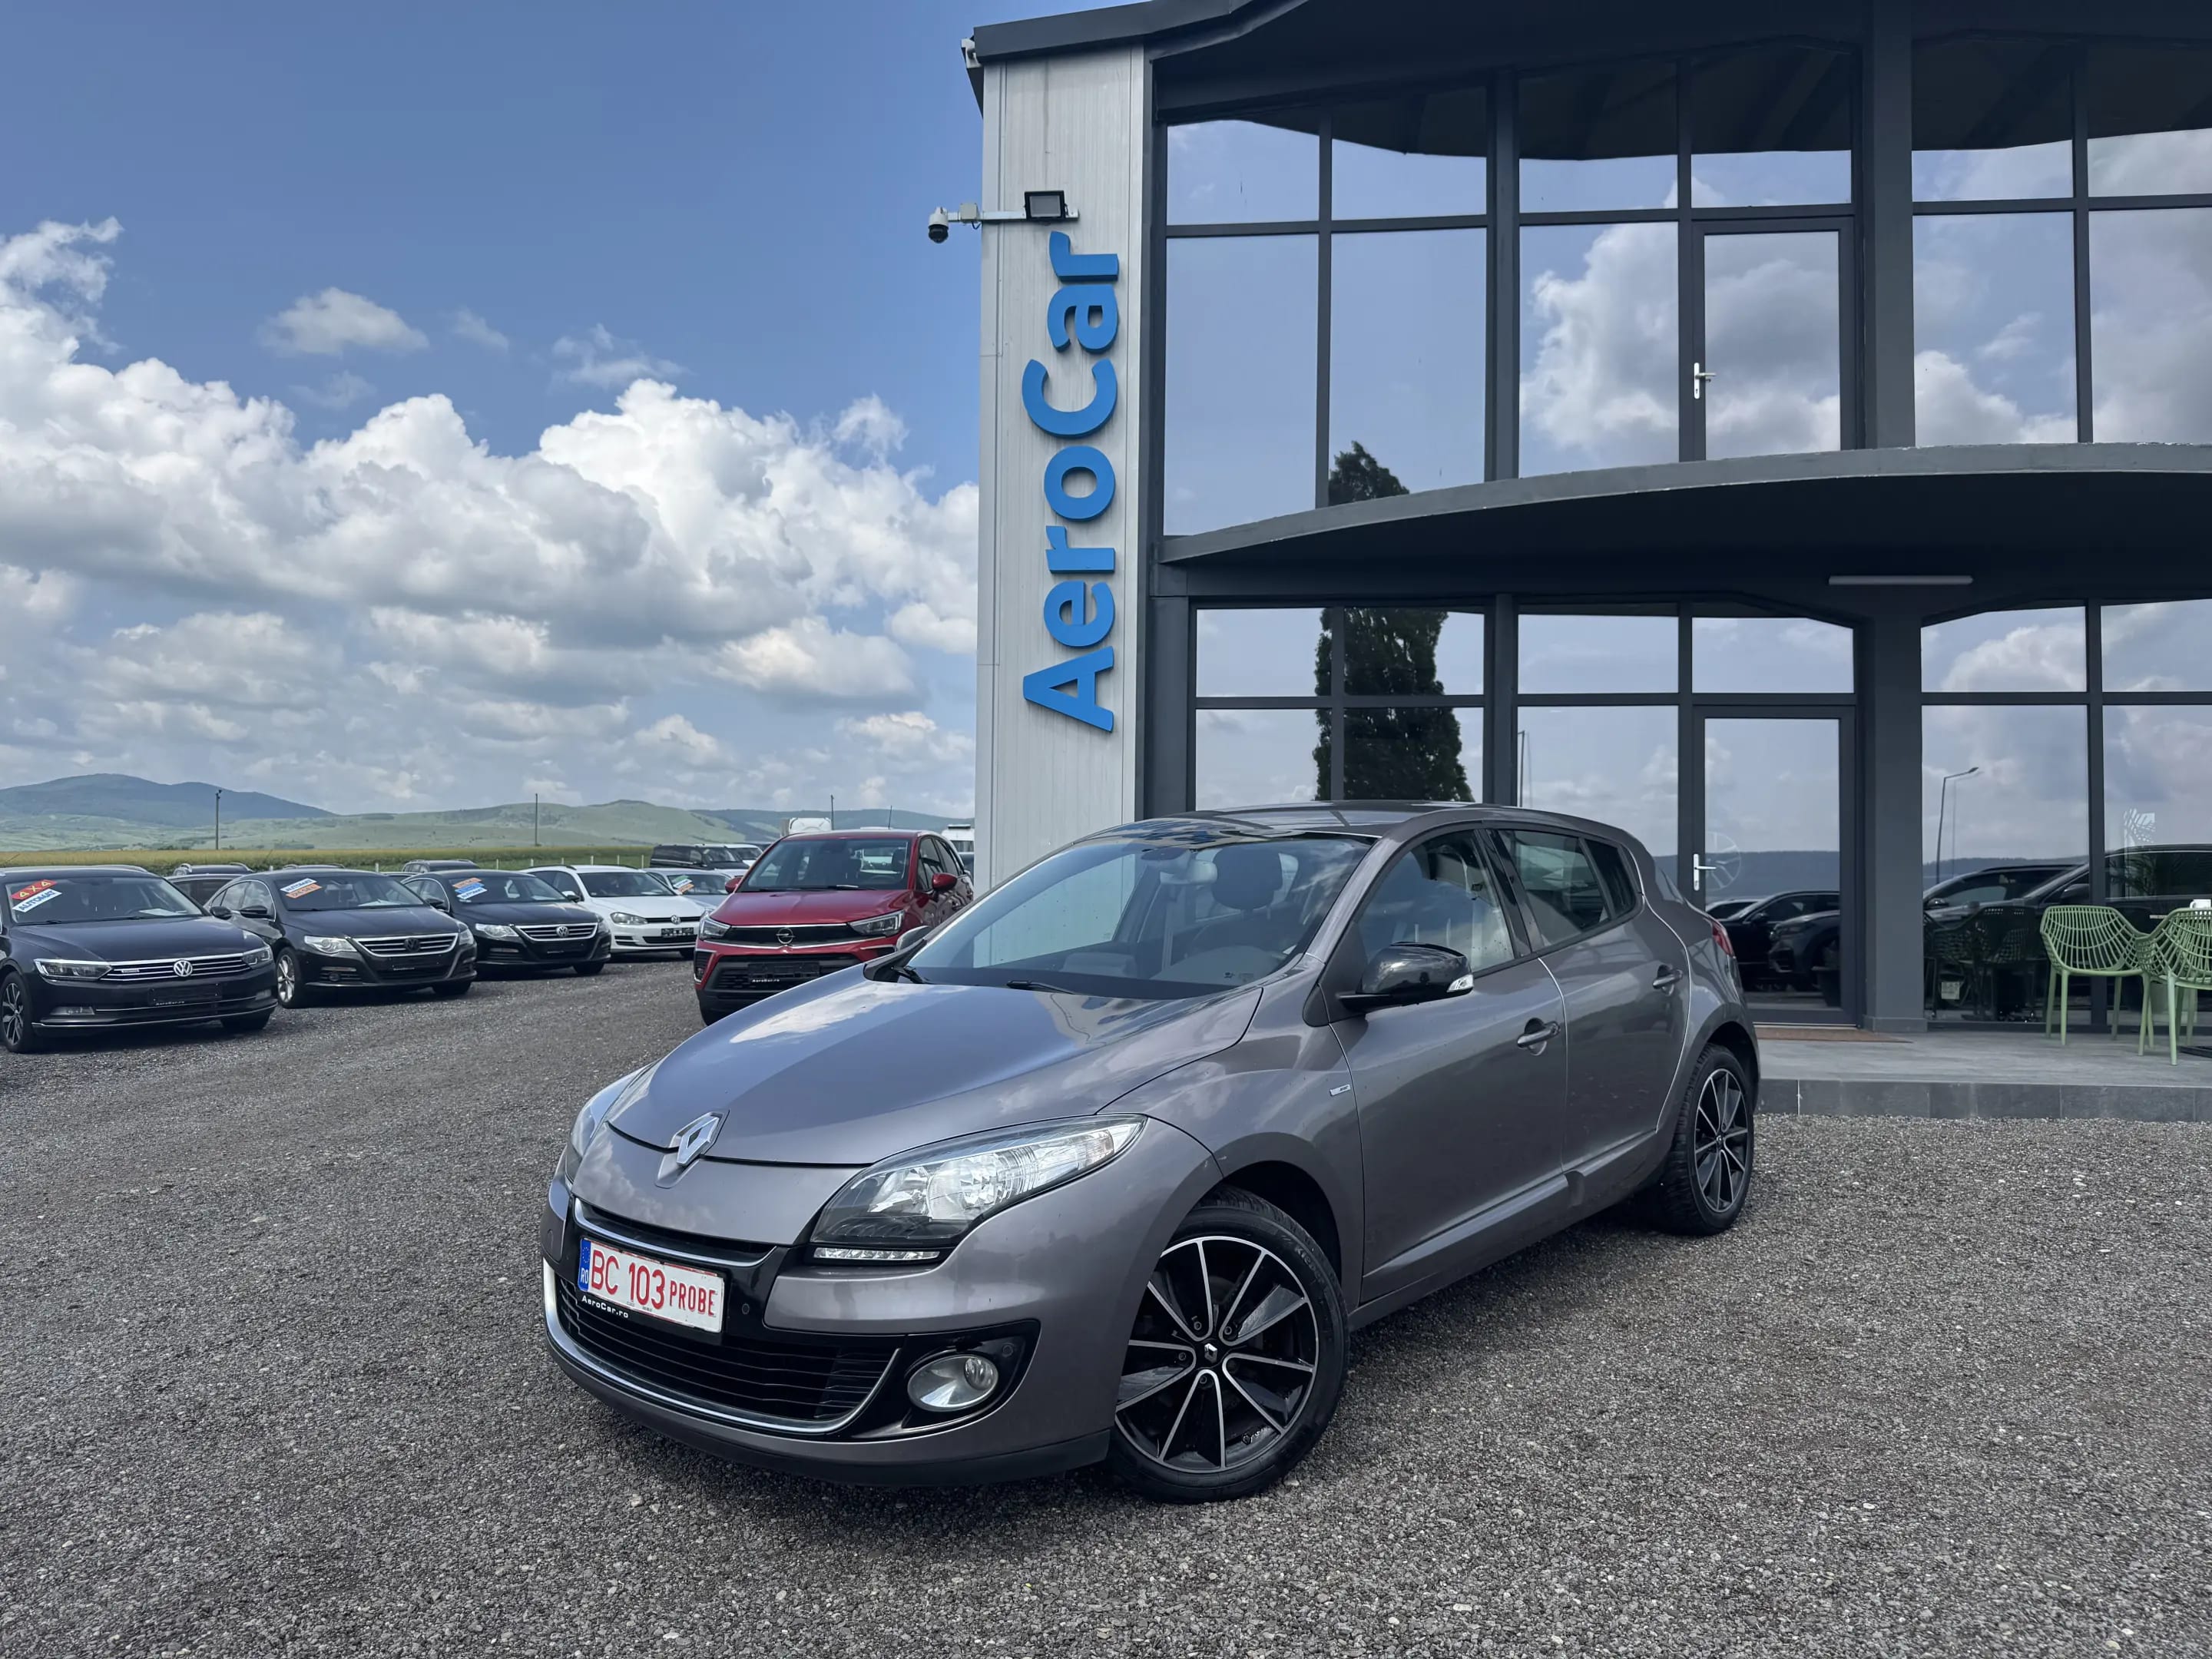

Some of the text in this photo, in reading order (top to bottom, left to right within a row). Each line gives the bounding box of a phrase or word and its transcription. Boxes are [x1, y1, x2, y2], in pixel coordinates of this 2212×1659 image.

[1022, 231, 1119, 732] AeroCar
[18, 890, 57, 911] AUTOMAT
[580, 1267, 589, 1284] RO
[591, 1250, 717, 1318] BC 103 PROBE
[581, 1295, 629, 1319] AeroCar.ro
